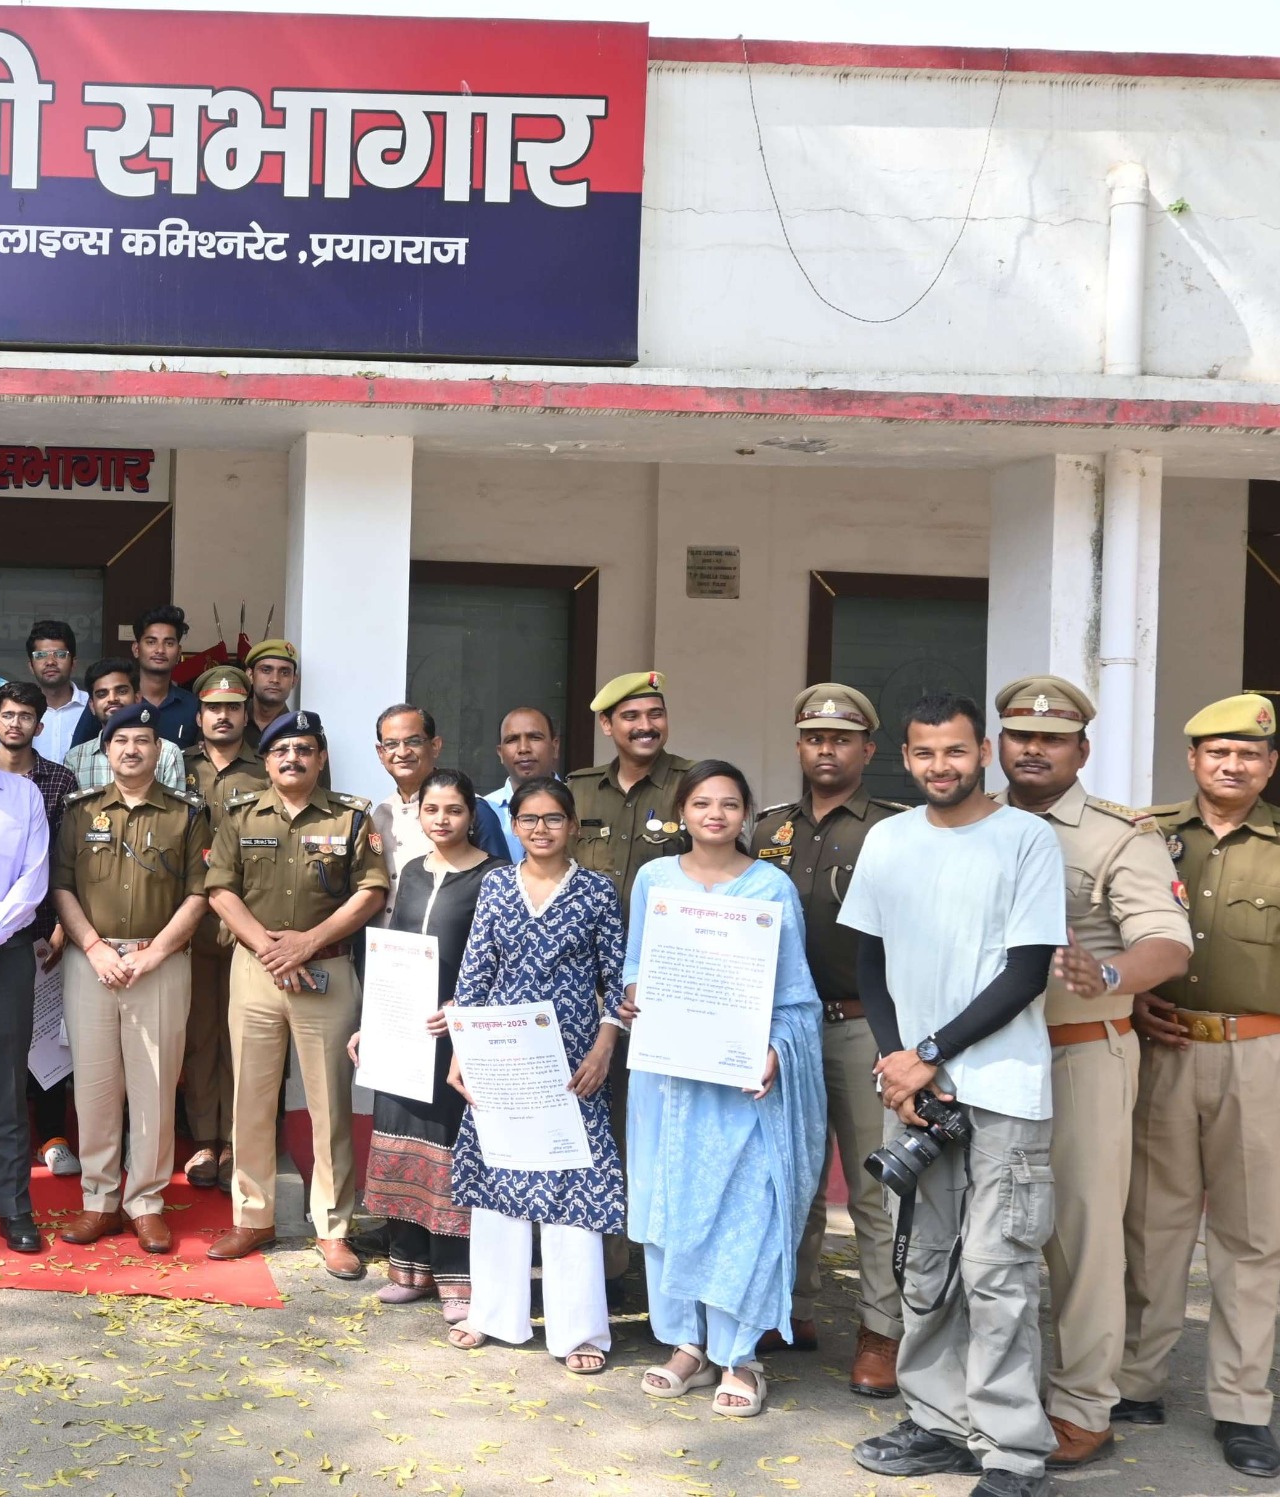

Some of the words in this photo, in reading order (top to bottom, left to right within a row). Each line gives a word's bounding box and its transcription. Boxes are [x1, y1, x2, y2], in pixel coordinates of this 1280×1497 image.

[82, 83, 607, 208] सभागार
[120, 217, 290, 261] कमिश्नरेट
[679, 905, 748, 923] महाकुम्भ-2025
[895, 1235, 906, 1272] SONY
